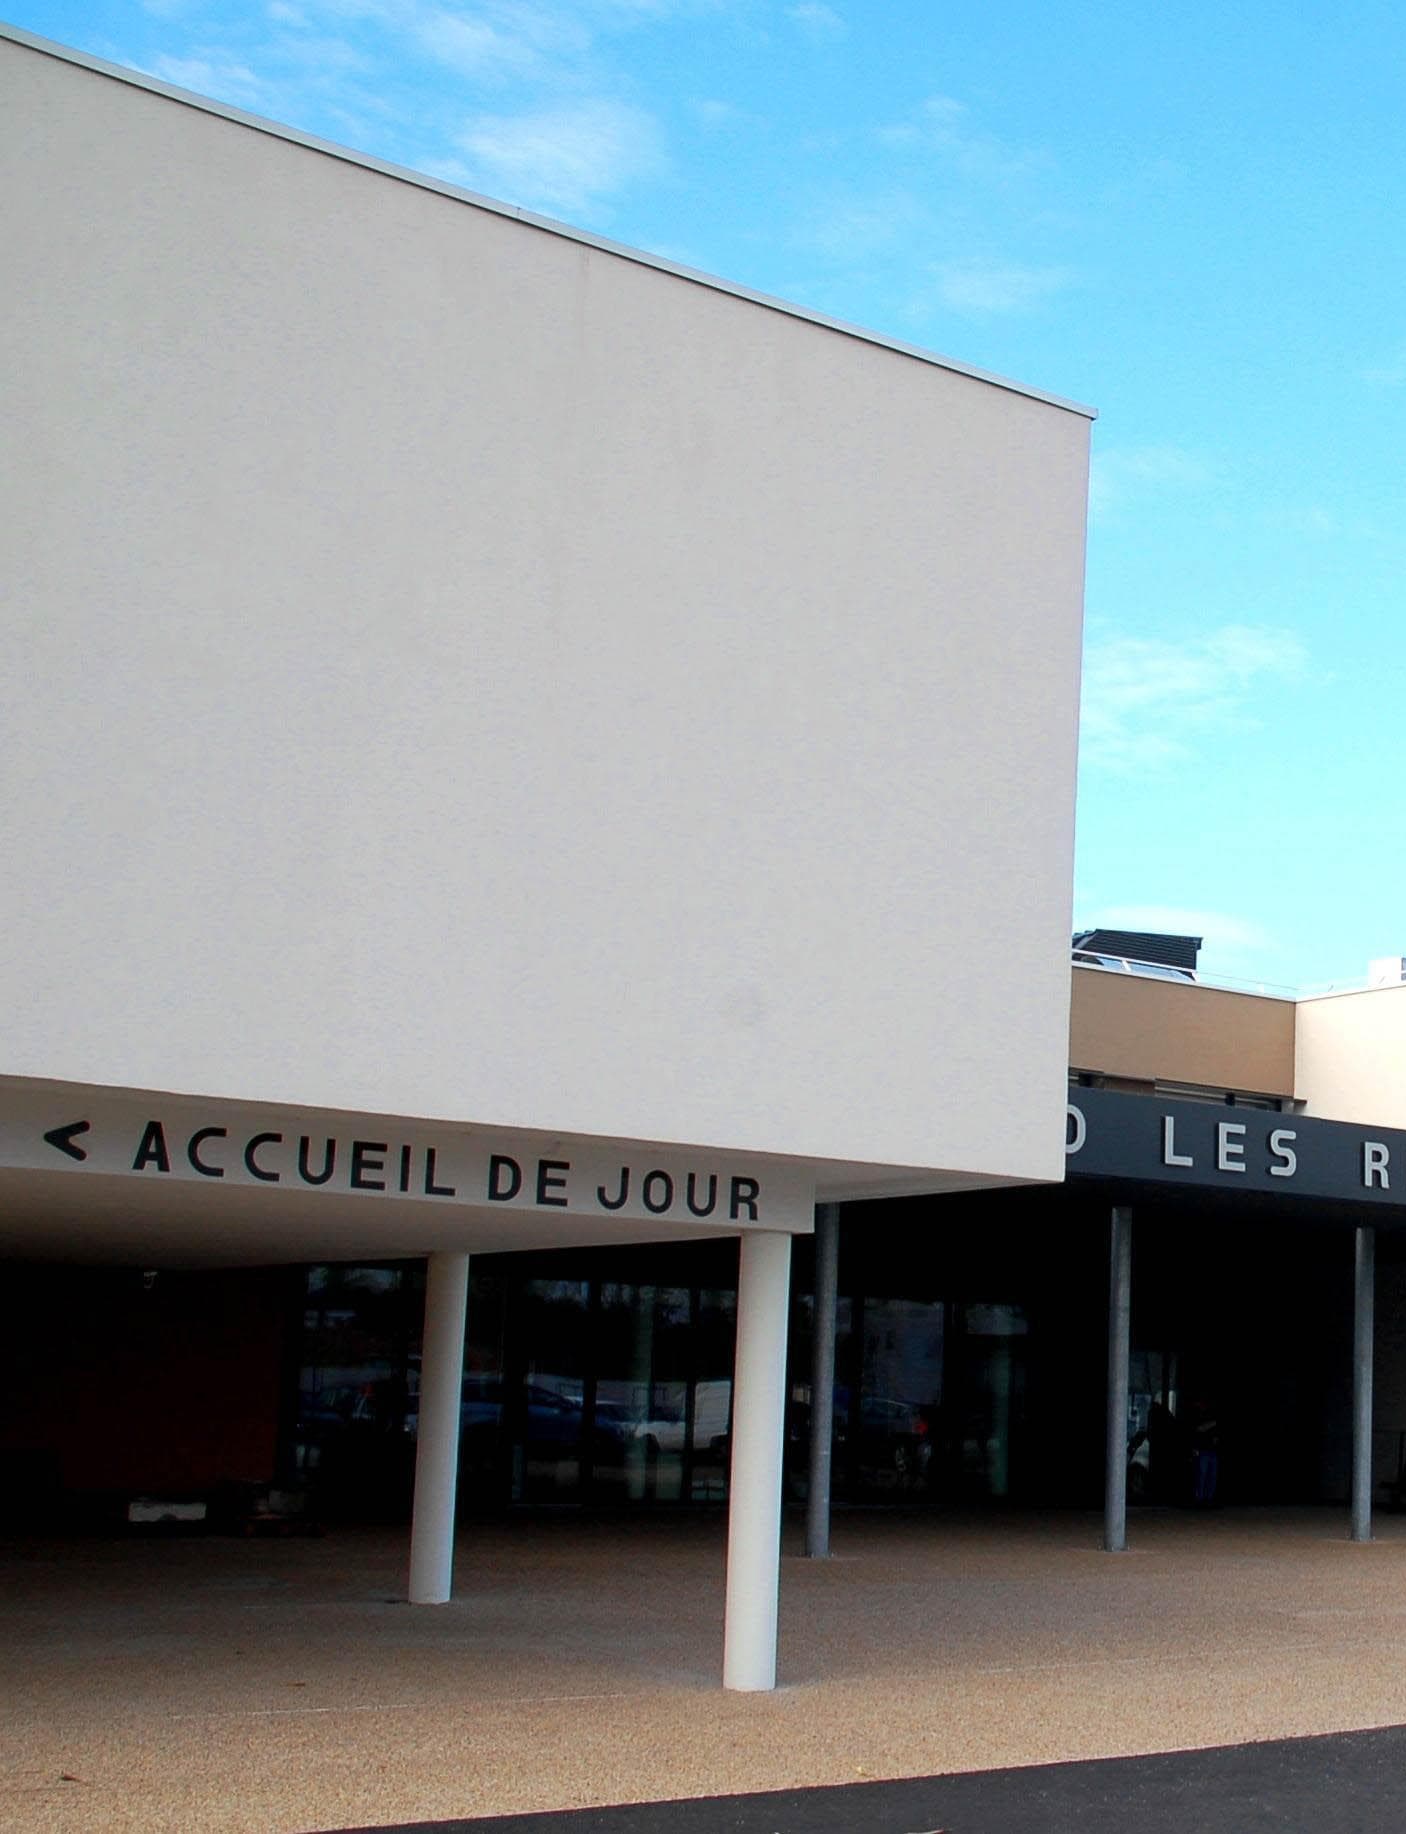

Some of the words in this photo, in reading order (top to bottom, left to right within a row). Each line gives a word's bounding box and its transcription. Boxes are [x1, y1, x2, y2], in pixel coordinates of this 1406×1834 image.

[131, 1119, 457, 1198] ACCUEIL
[487, 1153, 572, 1208] DE
[596, 1165, 761, 1223] JOUR
[1163, 1115, 1298, 1178] LES
